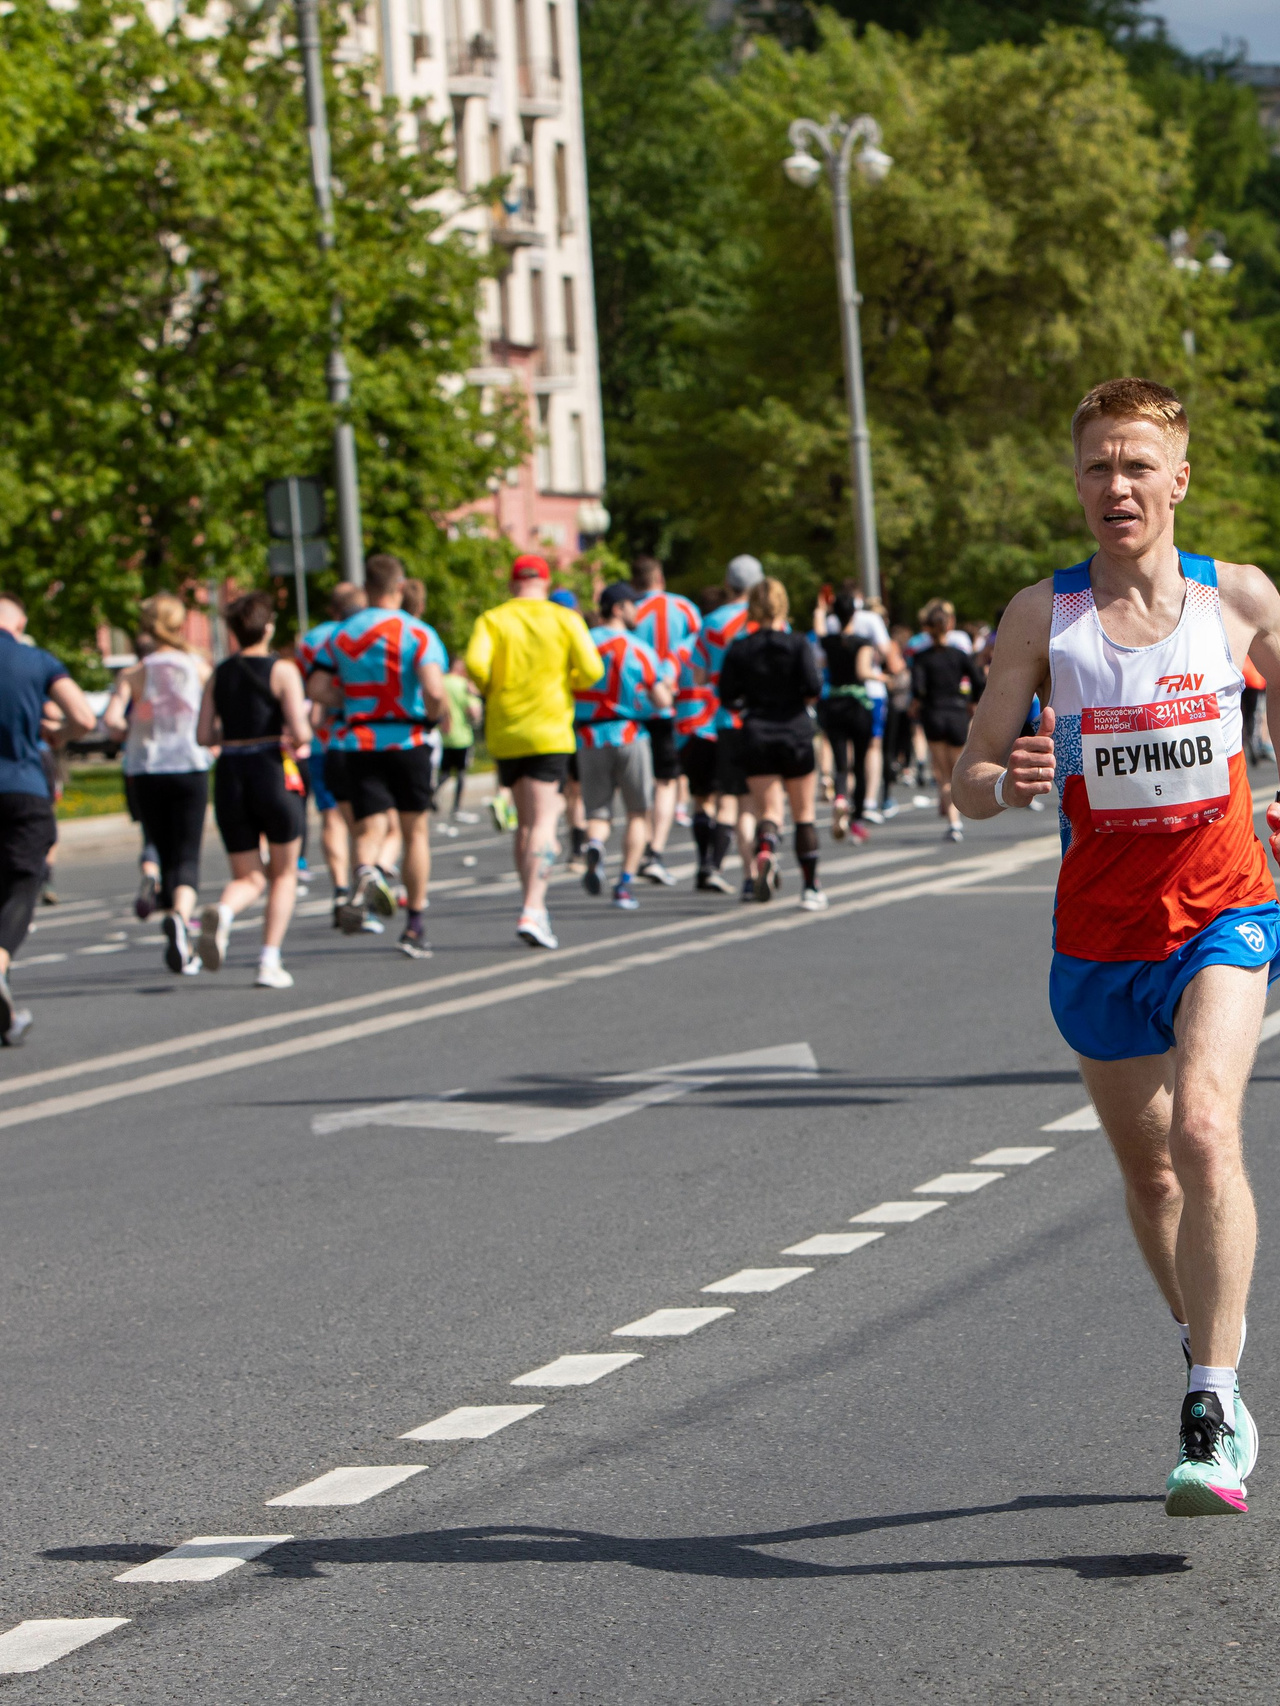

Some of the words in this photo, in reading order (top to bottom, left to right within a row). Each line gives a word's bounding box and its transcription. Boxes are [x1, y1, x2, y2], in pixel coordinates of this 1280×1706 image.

[1155, 673, 1204, 693] RAY
[1094, 707, 1143, 717] МОСКОВСКИЙ
[1190, 711, 1206, 720] 2023
[1094, 722, 1131, 731] МАРАФОН
[1095, 736, 1213, 776] РЕУНКОВ
[1154, 785, 1162, 796] 5
